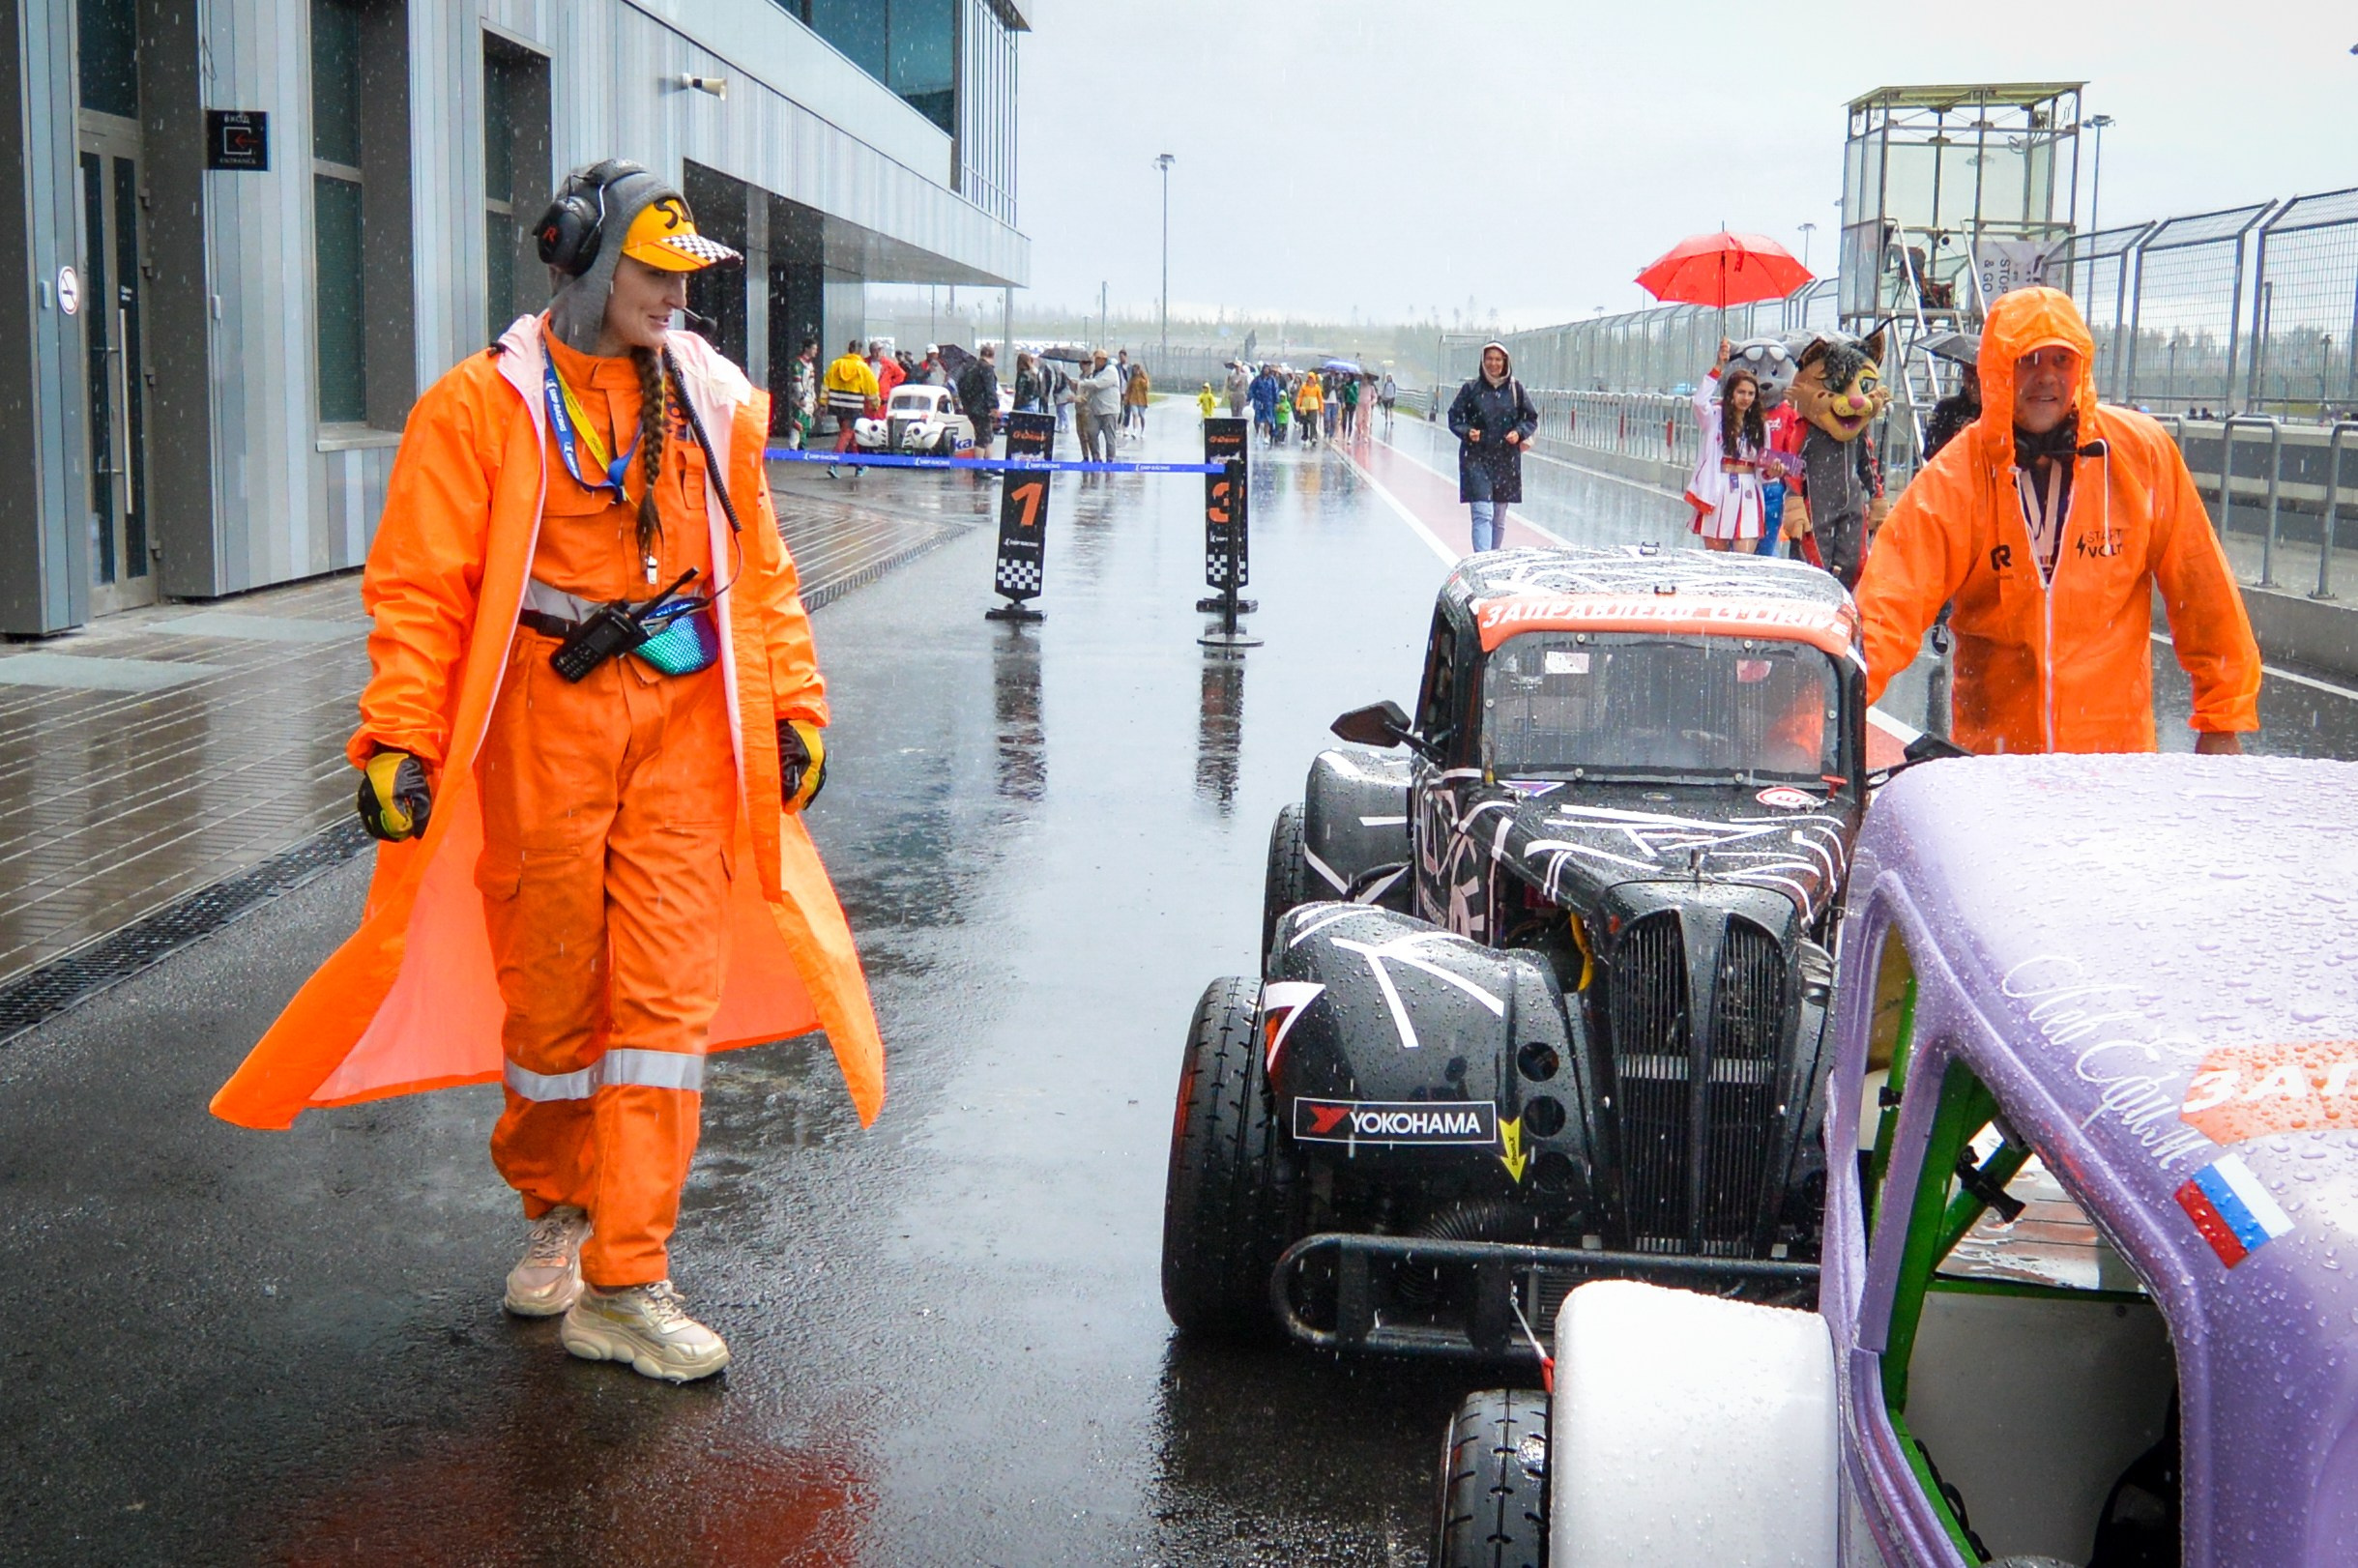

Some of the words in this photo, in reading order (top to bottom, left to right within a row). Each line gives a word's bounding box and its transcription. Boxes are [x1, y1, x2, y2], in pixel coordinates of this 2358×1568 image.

[1982, 273, 1994, 293] GO
[1998, 258, 2011, 294] STOP
[1011, 483, 1043, 526] 1
[1350, 1112, 1481, 1134] YOKOHAMA
